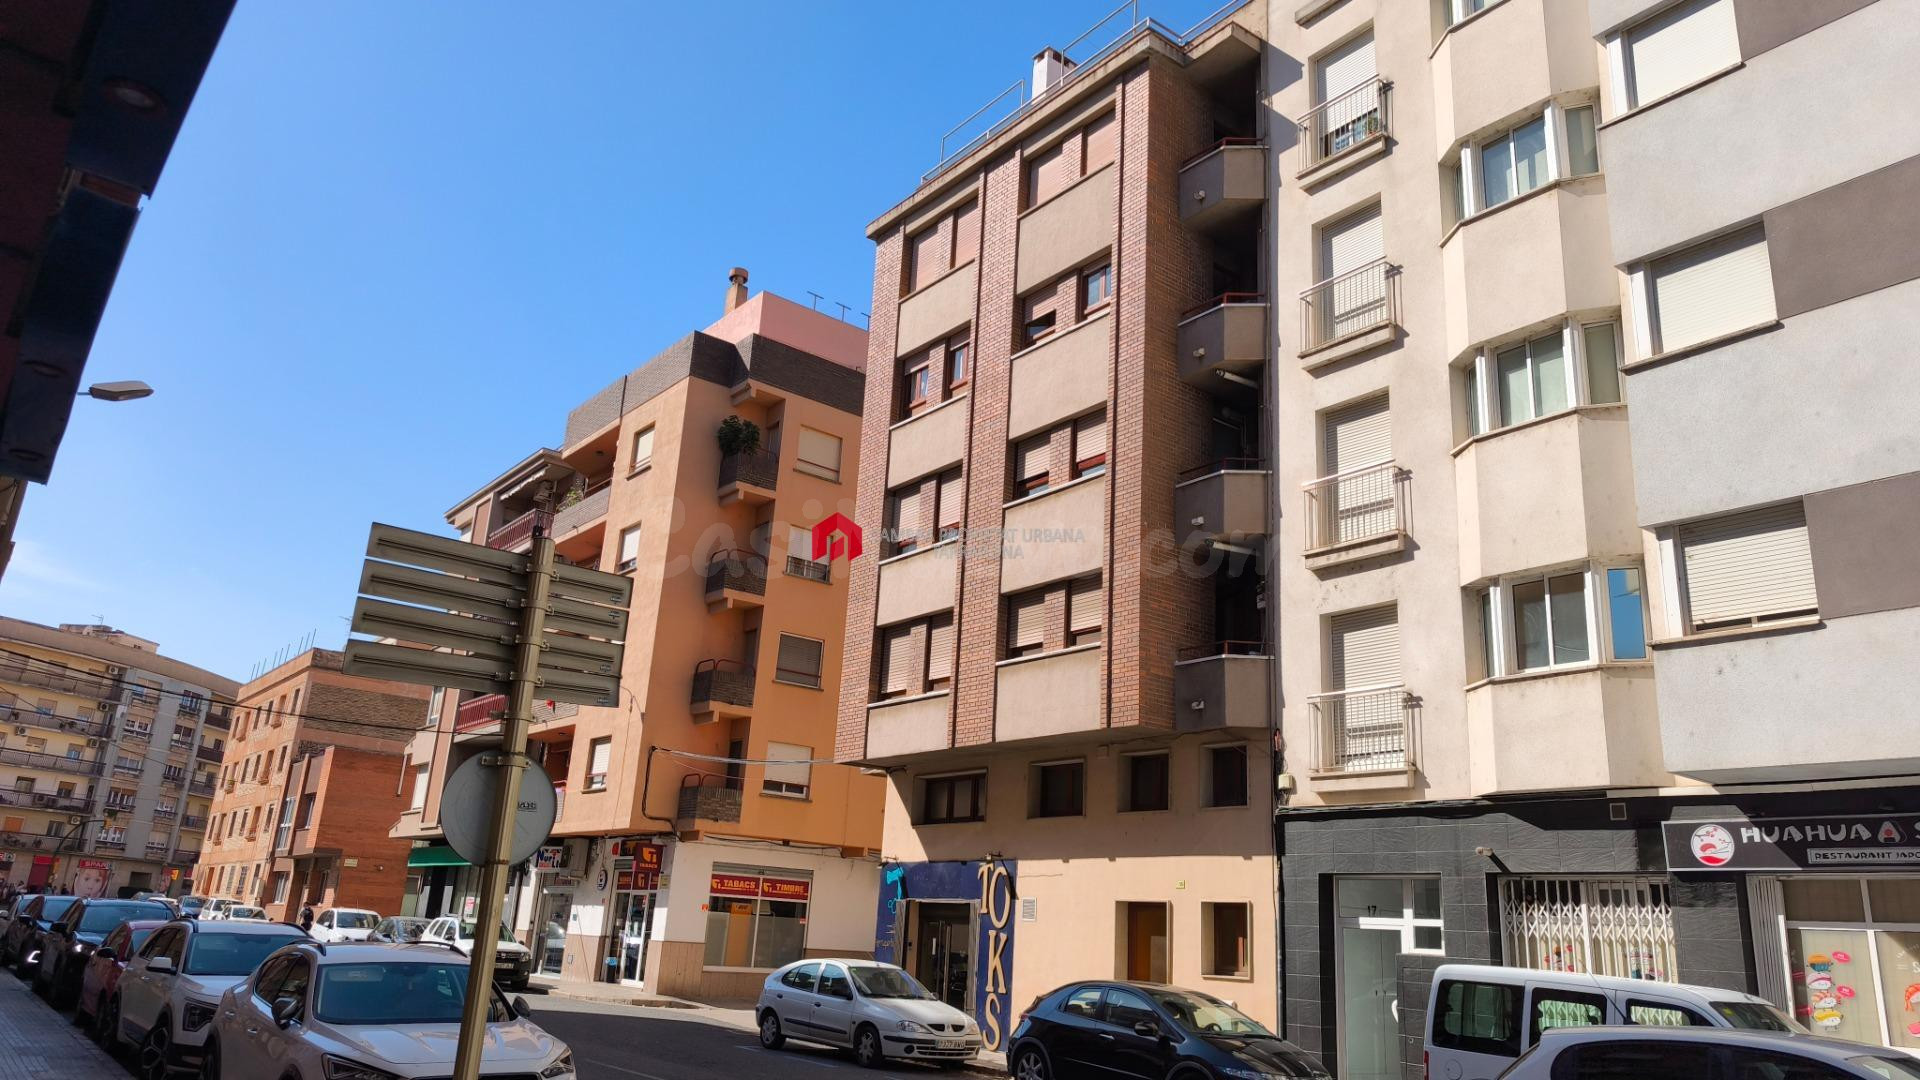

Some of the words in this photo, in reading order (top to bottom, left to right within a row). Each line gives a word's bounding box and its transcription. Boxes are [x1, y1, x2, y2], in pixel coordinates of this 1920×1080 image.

[1740, 823, 1872, 844] HUAHUA
[1814, 851, 1893, 860] RESTAURANT
[723, 879, 756, 889] TABACS
[775, 883, 804, 893] TIMBRE
[1367, 905, 1377, 917] 17
